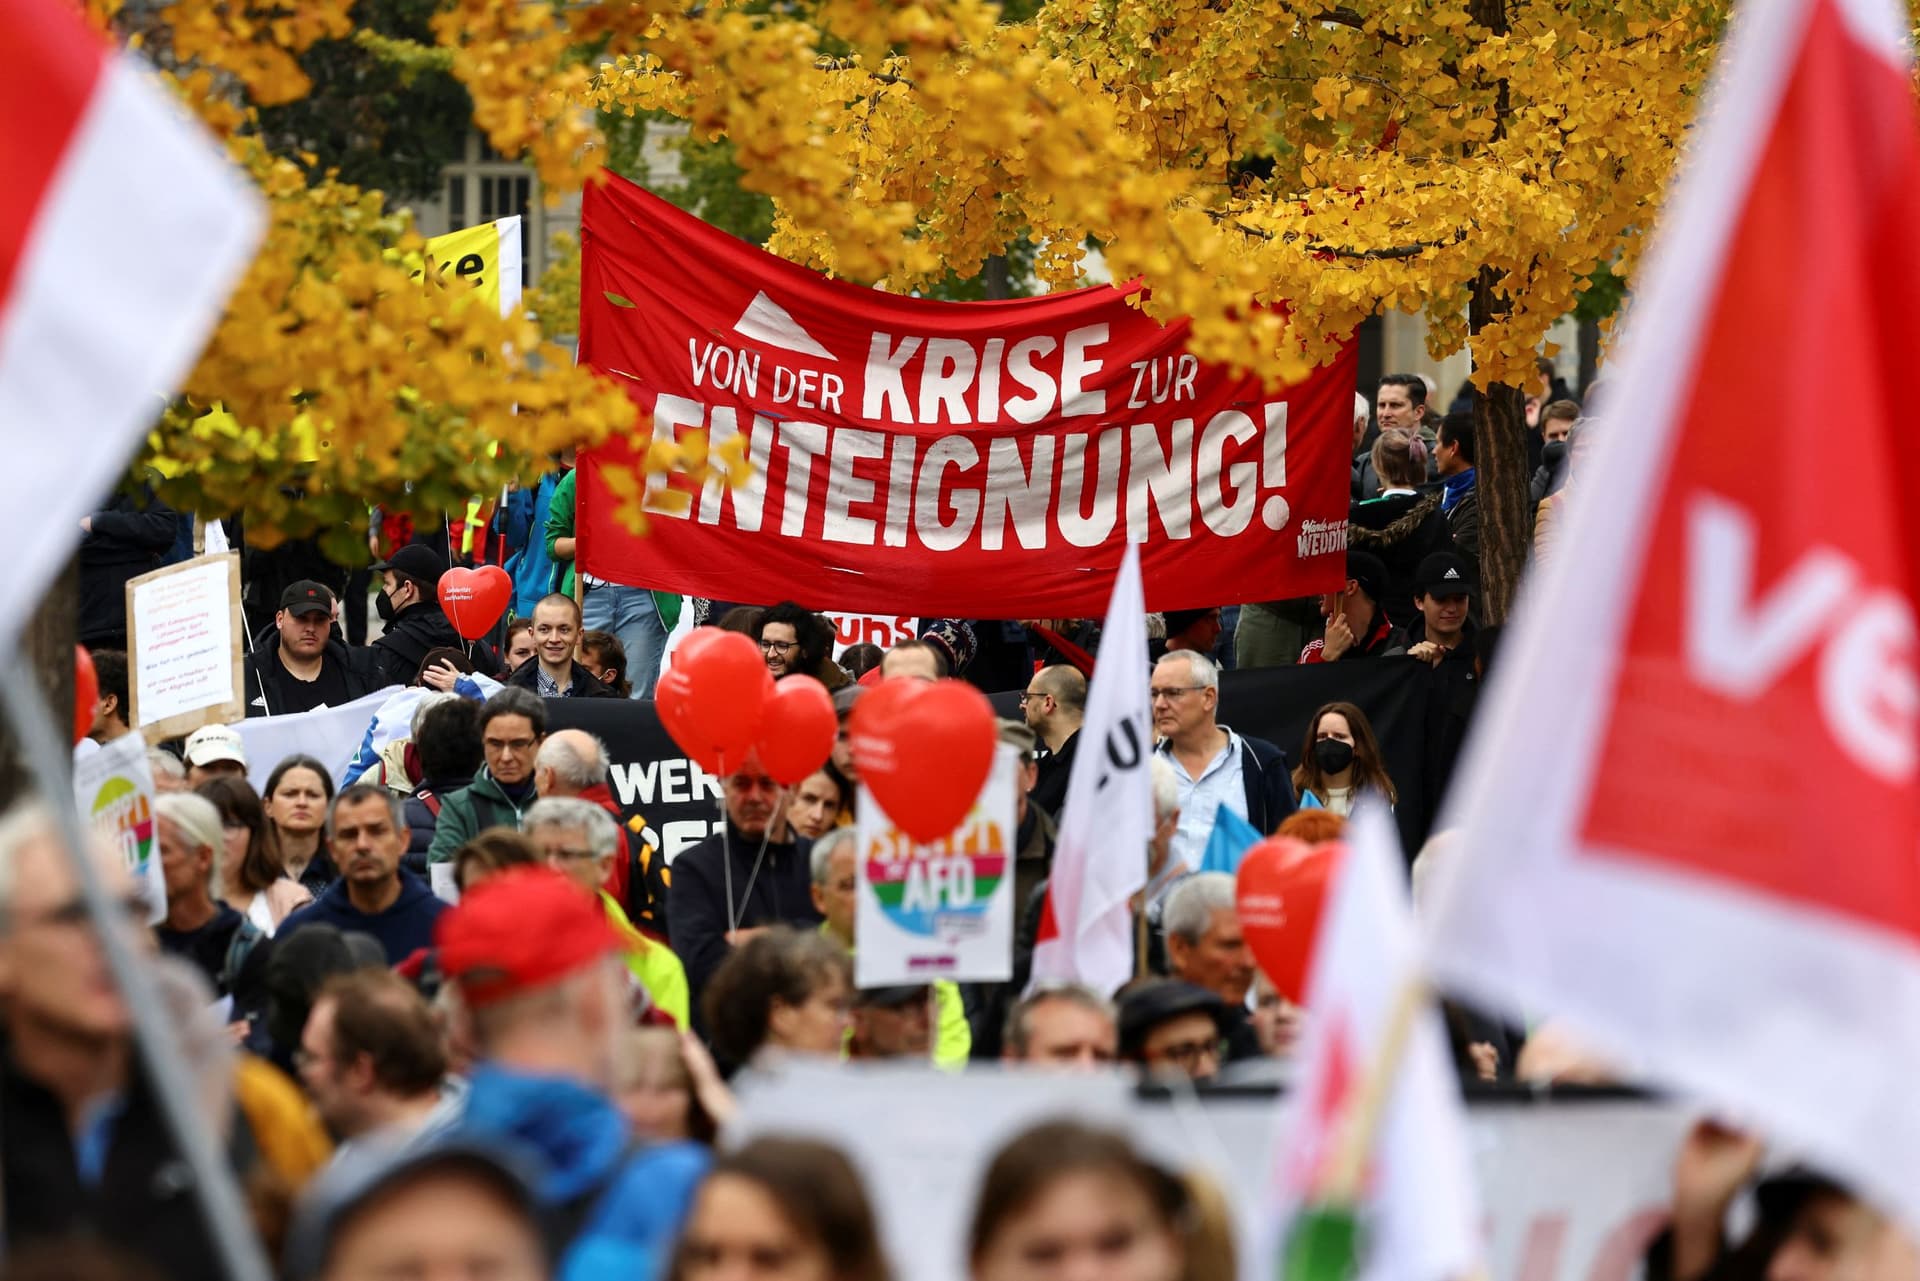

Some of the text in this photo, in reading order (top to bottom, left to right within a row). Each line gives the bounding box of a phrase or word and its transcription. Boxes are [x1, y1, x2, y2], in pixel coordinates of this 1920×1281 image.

[689, 323, 1198, 424] VON DER KRISE ZUR
[641, 392, 1290, 551] ENTEIGNUNG!
